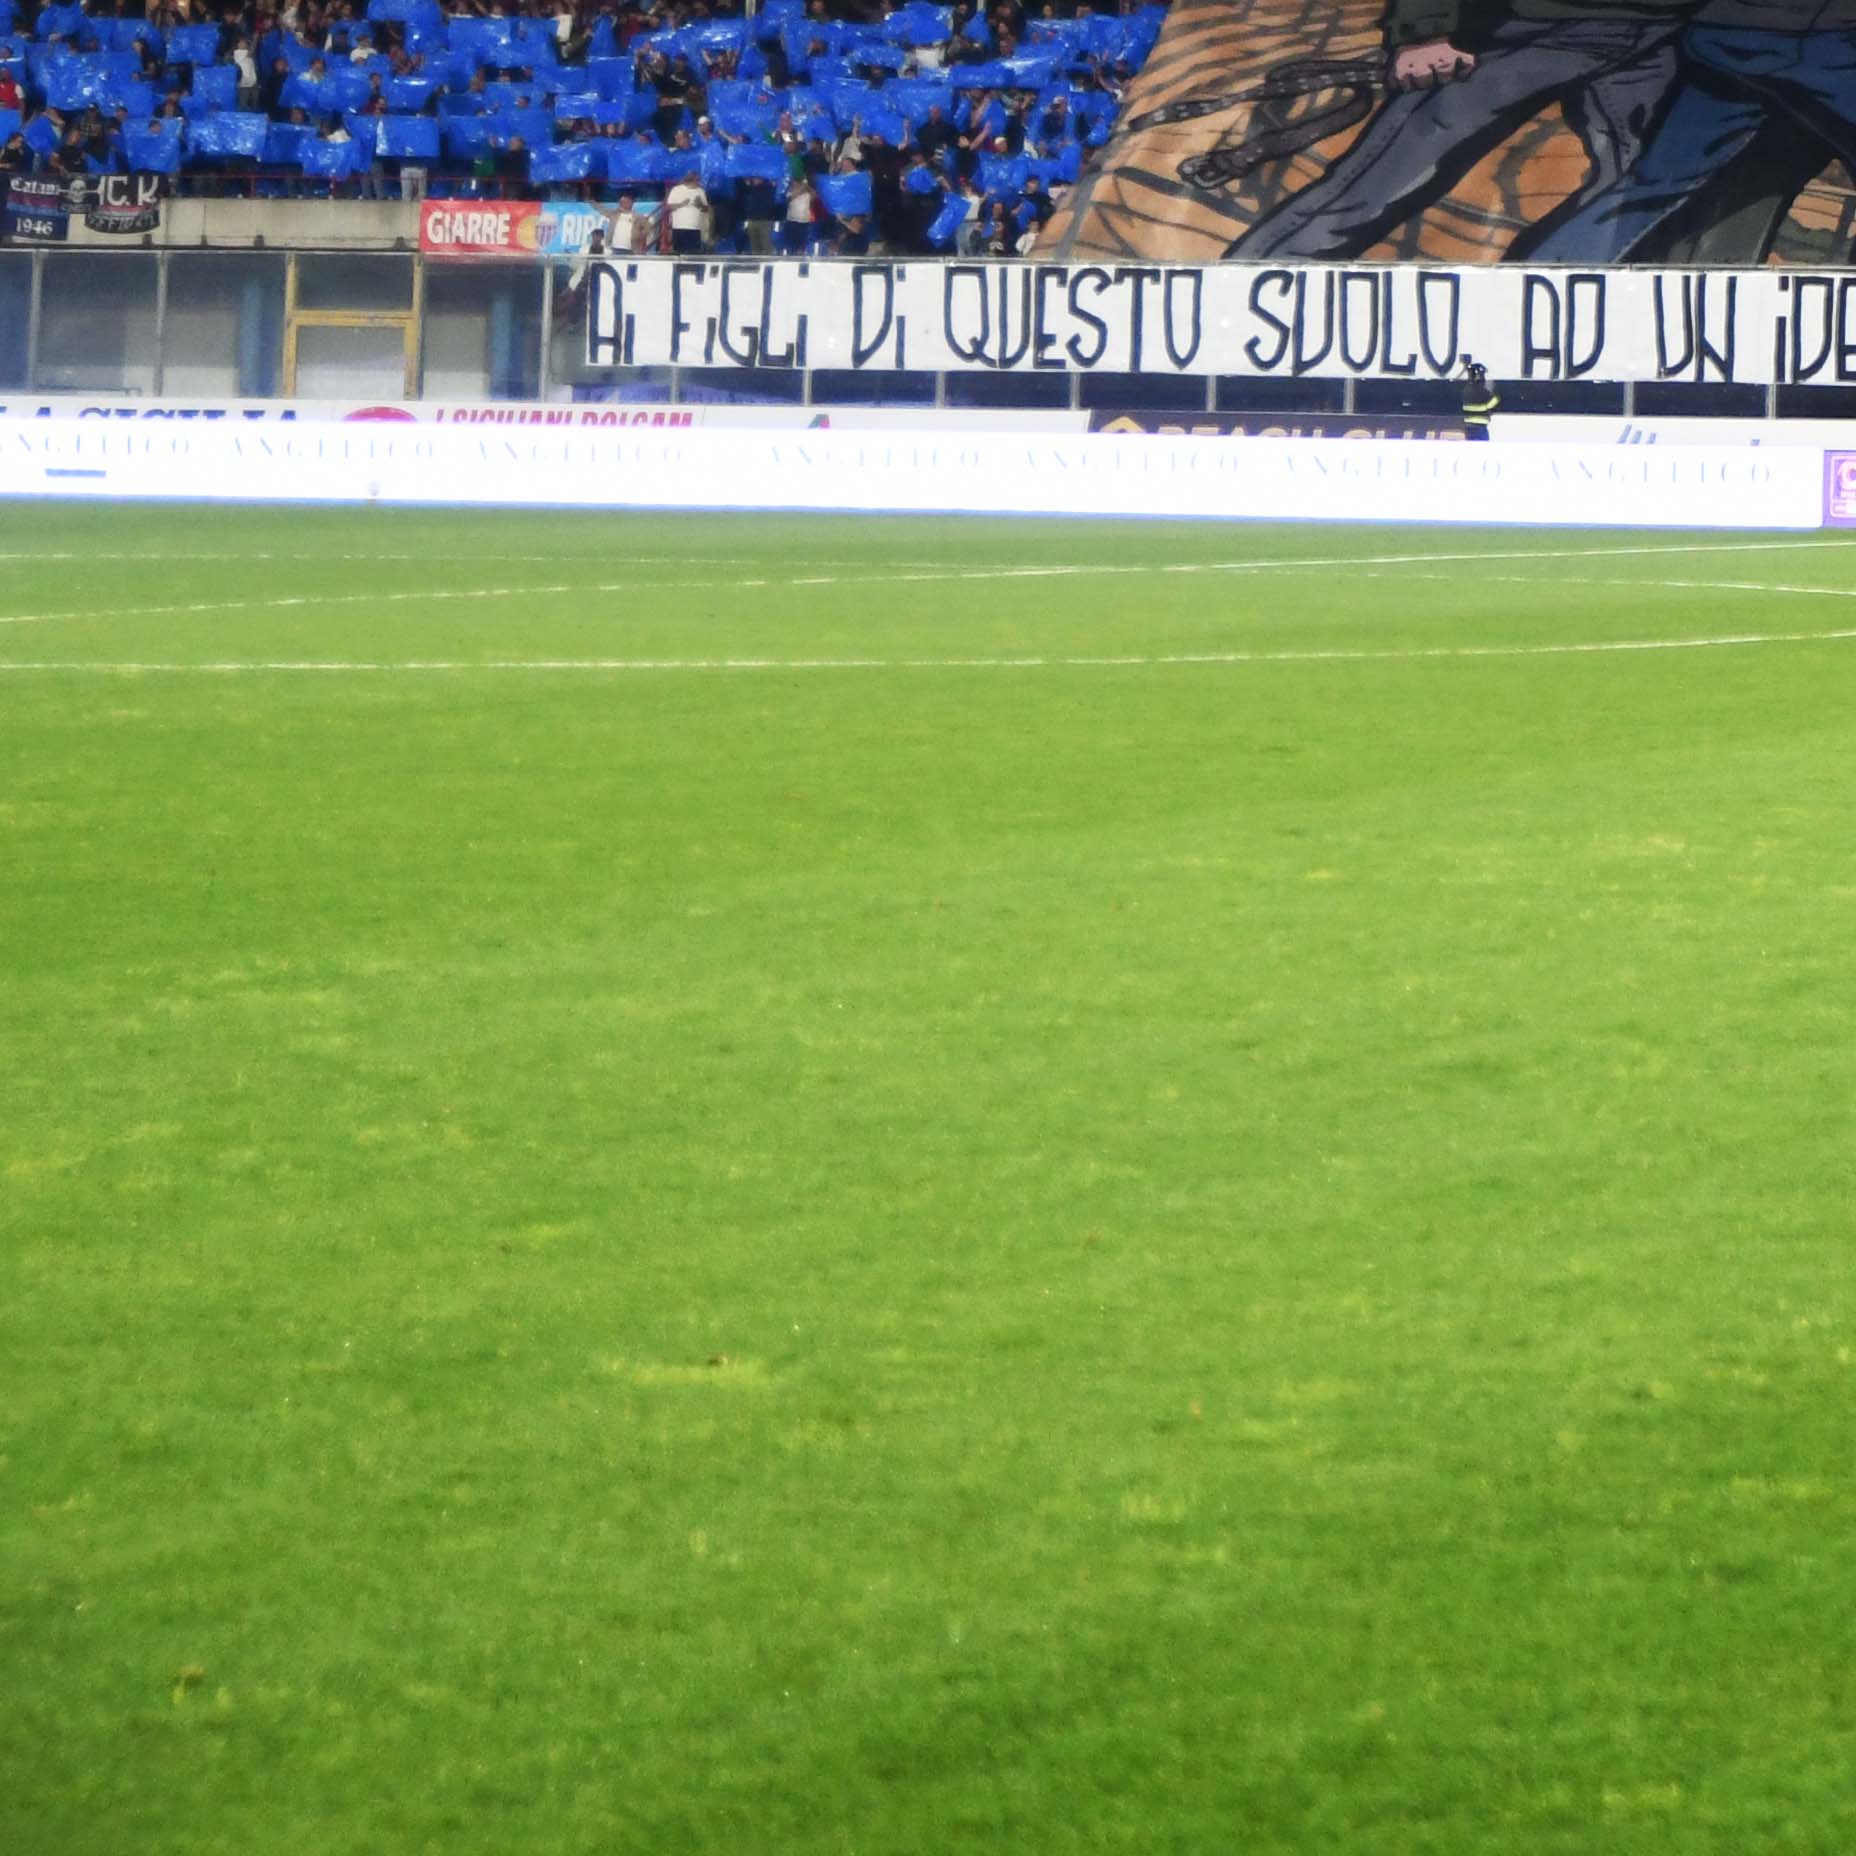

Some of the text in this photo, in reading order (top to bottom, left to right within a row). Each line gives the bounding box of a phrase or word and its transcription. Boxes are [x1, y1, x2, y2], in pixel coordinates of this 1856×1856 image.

[16, 216, 54, 235] 1946
[426, 210, 511, 245] GIARRE
[944, 266, 1204, 374] QUESTO
[1521, 273, 1606, 379] AD
[1653, 274, 1736, 384] UN
